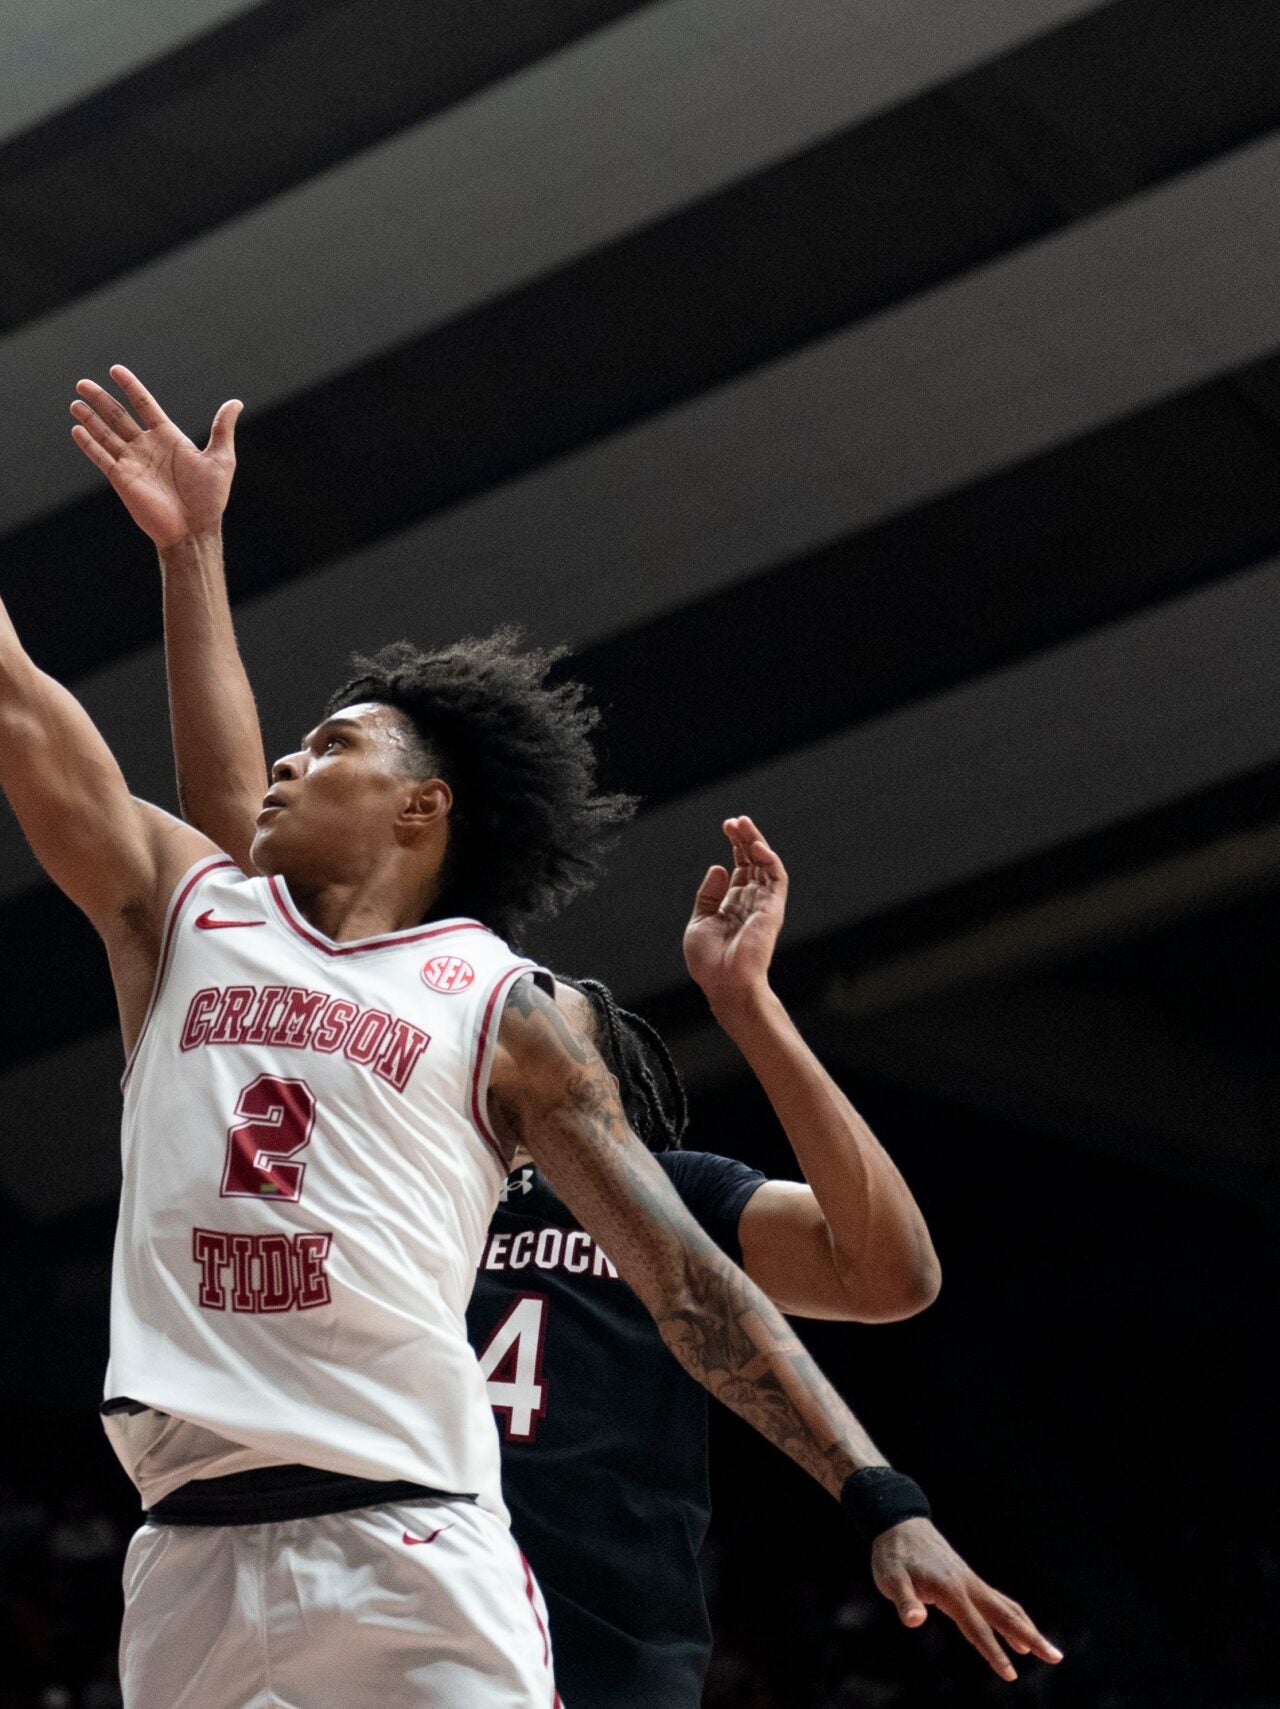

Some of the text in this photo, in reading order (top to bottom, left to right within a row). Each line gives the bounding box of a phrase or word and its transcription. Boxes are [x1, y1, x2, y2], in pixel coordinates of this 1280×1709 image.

[423, 956, 475, 991] SEC
[180, 986, 431, 1093] CRIMSON
[220, 1073, 316, 1202] 2
[193, 1227, 332, 1313] TIDE
[477, 1227, 619, 1279] ECOCK
[478, 1291, 548, 1441] 4
